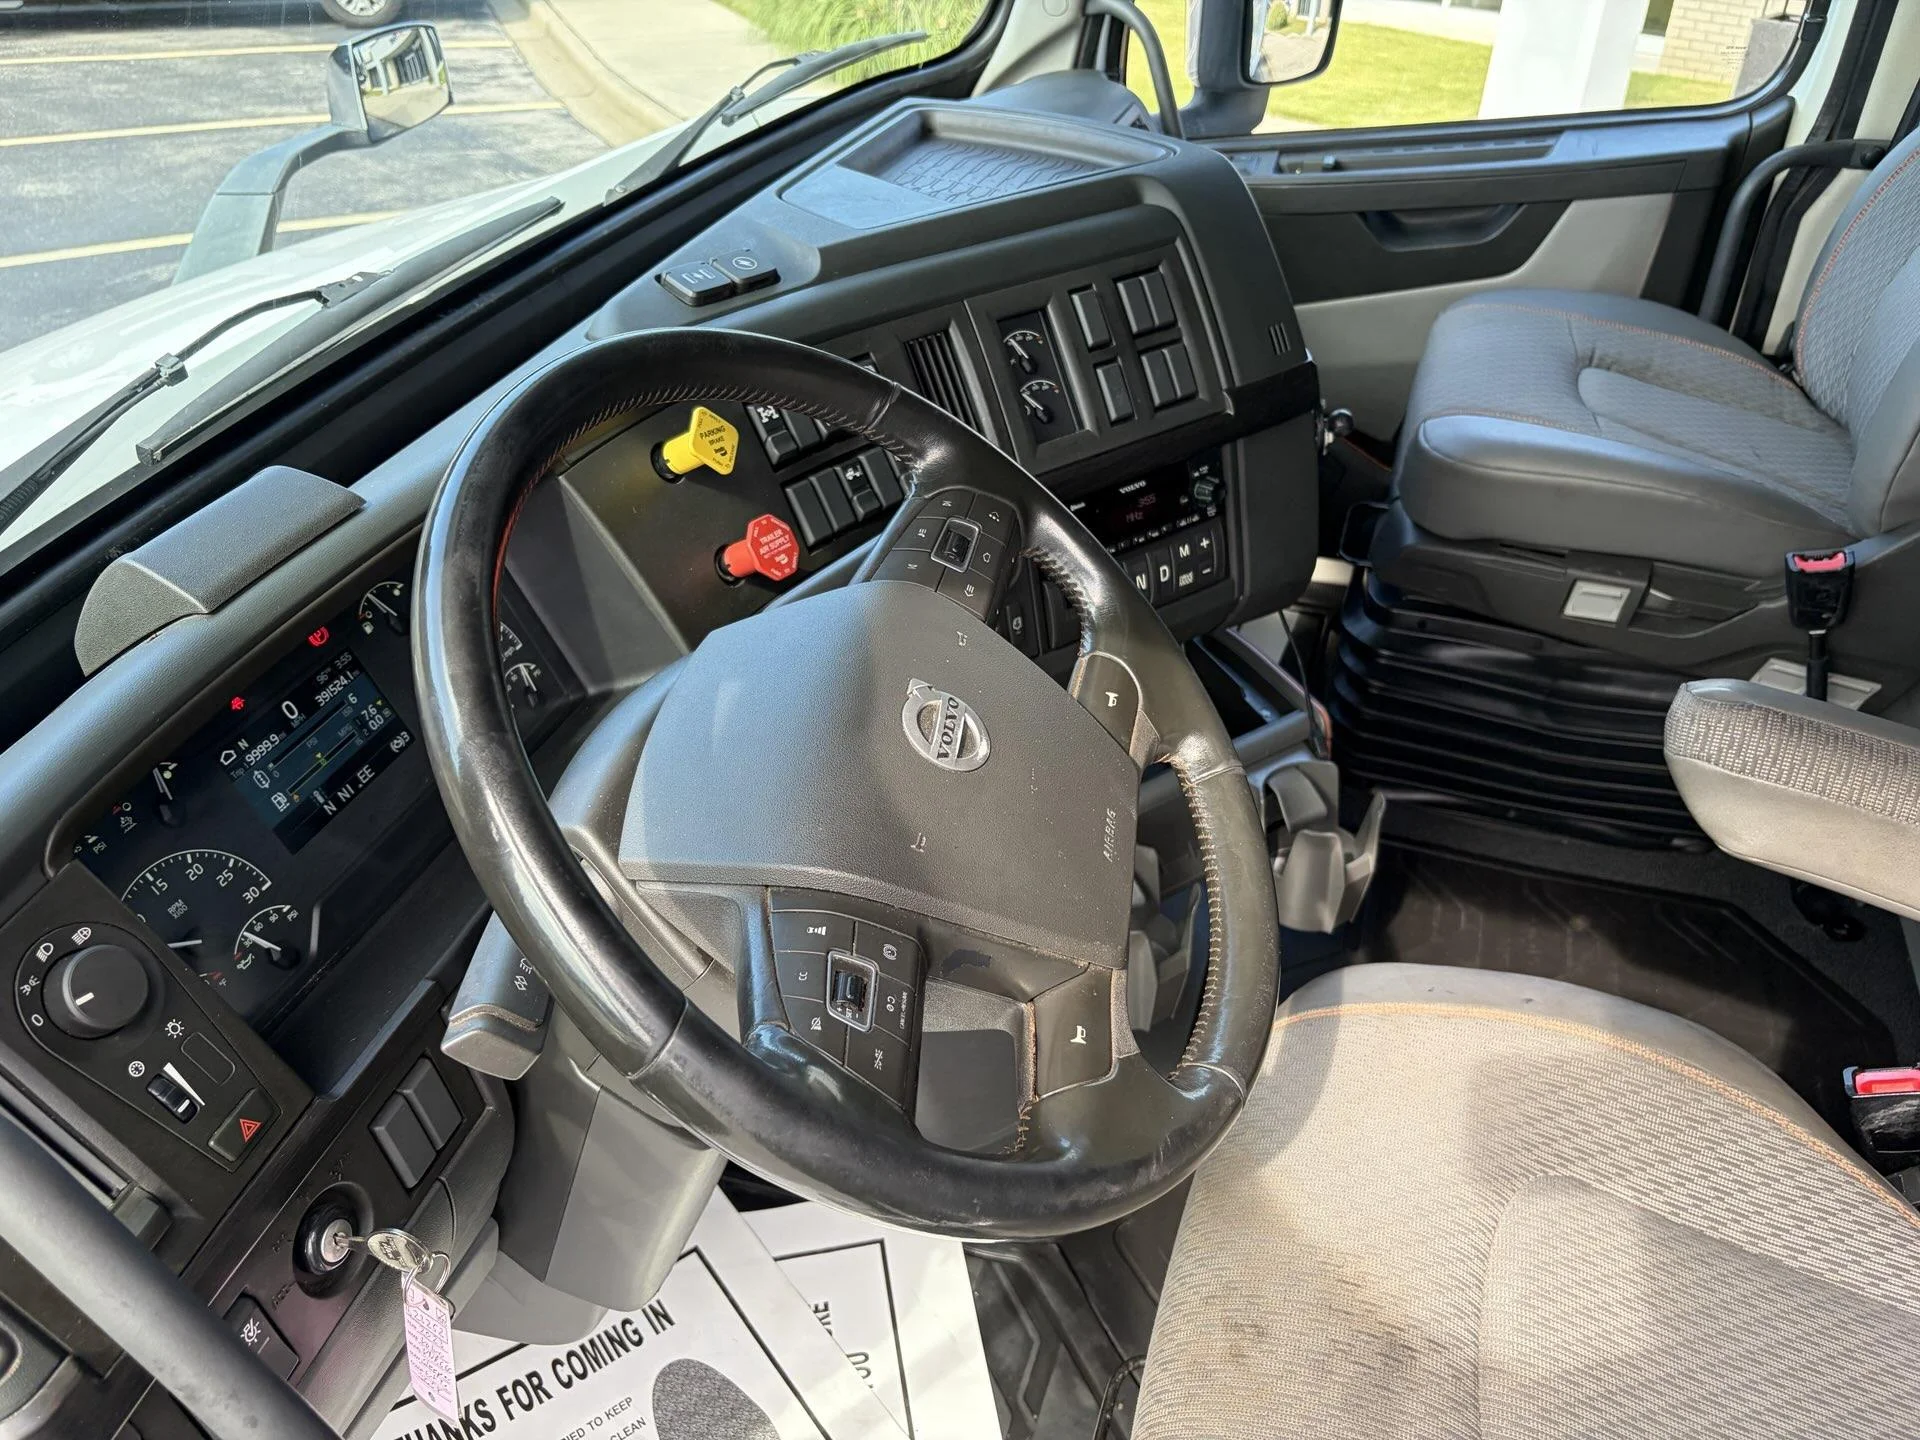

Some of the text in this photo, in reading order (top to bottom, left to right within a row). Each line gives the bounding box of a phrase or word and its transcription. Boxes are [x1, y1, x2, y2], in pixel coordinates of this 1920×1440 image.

[699, 425, 726, 440] PARKING
[709, 435, 725, 446] BRAKE
[1118, 480, 1147, 494] VOLVO
[759, 544, 770, 556] AIR
[768, 534, 790, 550] SUPPLY
[760, 528, 784, 545] TRAILER
[1178, 543, 1191, 559] M
[1135, 573, 1148, 591] N
[1159, 565, 1171, 583] D
[314, 670, 355, 708] 391524.1
[348, 693, 358, 704] 6
[281, 700, 299, 720] 0
[361, 704, 378, 722] 7.6
[368, 714, 385, 731] 0.0
[937, 697, 960, 759] VOLVO
[237, 738, 250, 751] N
[245, 733, 280, 766] 9999.9
[323, 800, 337, 815] N
[1103, 807, 1116, 863] AIRBAG
[92, 841, 108, 855] PSI
[185, 863, 205, 882] 20
[216, 868, 235, 888] 25
[150, 878, 169, 896] 15
[242, 886, 261, 905] 30
[167, 898, 184, 917] RPM
[495, 1370, 554, 1422] FOR
[551, 1317, 644, 1390] COMING
[641, 1298, 676, 1336] IN
[586, 1416, 604, 1431] TO
[604, 1396, 633, 1420] KEEP
[609, 1417, 647, 1440] CLEAN
